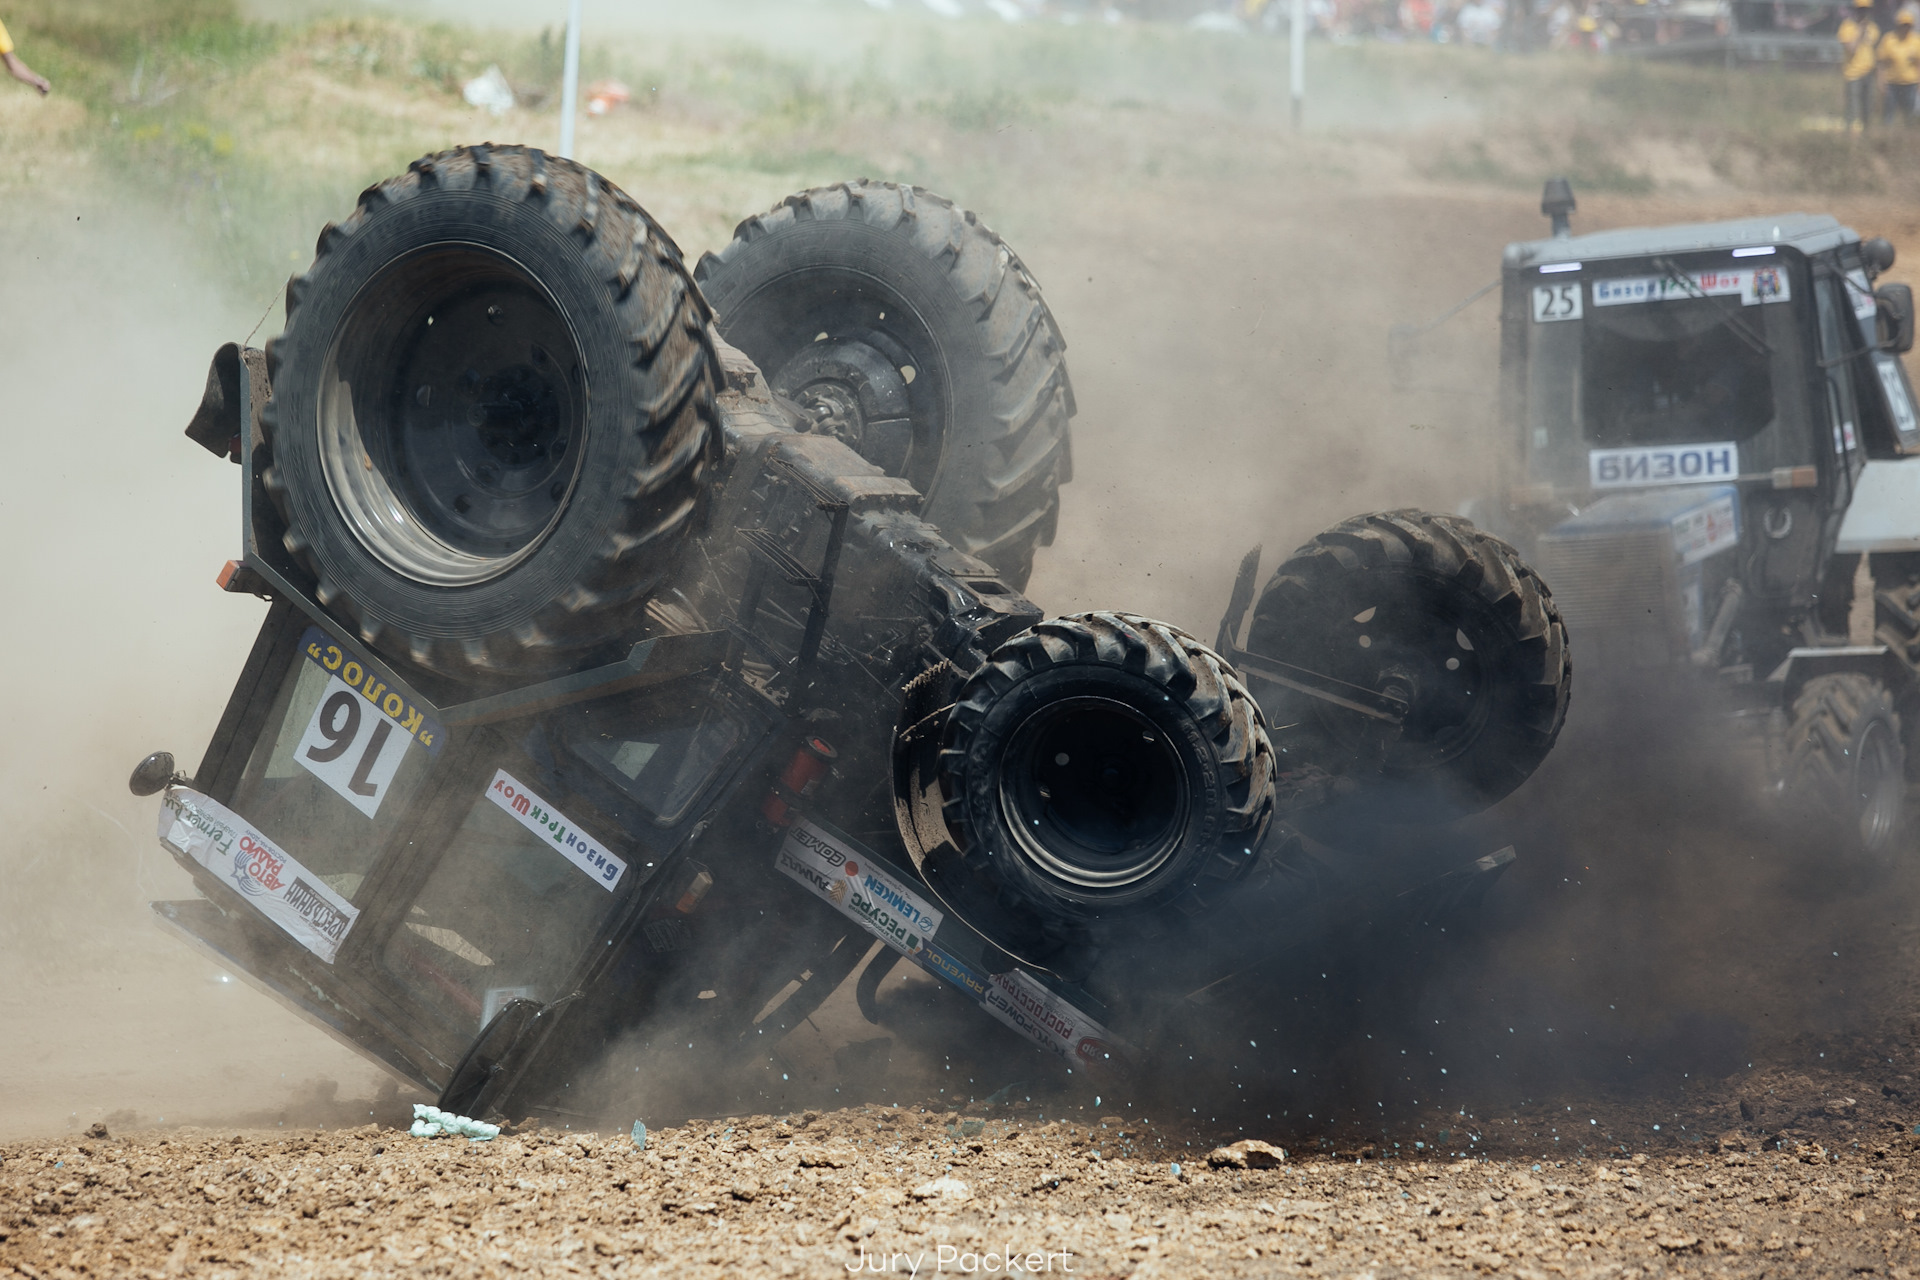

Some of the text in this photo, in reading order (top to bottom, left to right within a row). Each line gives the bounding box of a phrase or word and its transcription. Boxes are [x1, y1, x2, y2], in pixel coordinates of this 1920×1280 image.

[1542, 286, 1573, 315] 25
[1599, 450, 1729, 482] БИЗОН
[305, 693, 393, 796] 16
[244, 828, 287, 862] РОСТОВ-НА-ДОНУ
[493, 779, 618, 880] БизонТрекШоу
[789, 826, 846, 866] COMET
[237, 834, 283, 875] РАДИО
[245, 860, 285, 890] АВТО
[779, 853, 829, 891] АЛМАЗ
[282, 882, 346, 940] КРЕСТЬЯНИН
[849, 892, 906, 939] РЕСУРС
[863, 874, 920, 923] LEMKEN
[926, 948, 984, 993] RAVENOL
[994, 973, 1072, 1039] РОСГОССТРАХ
